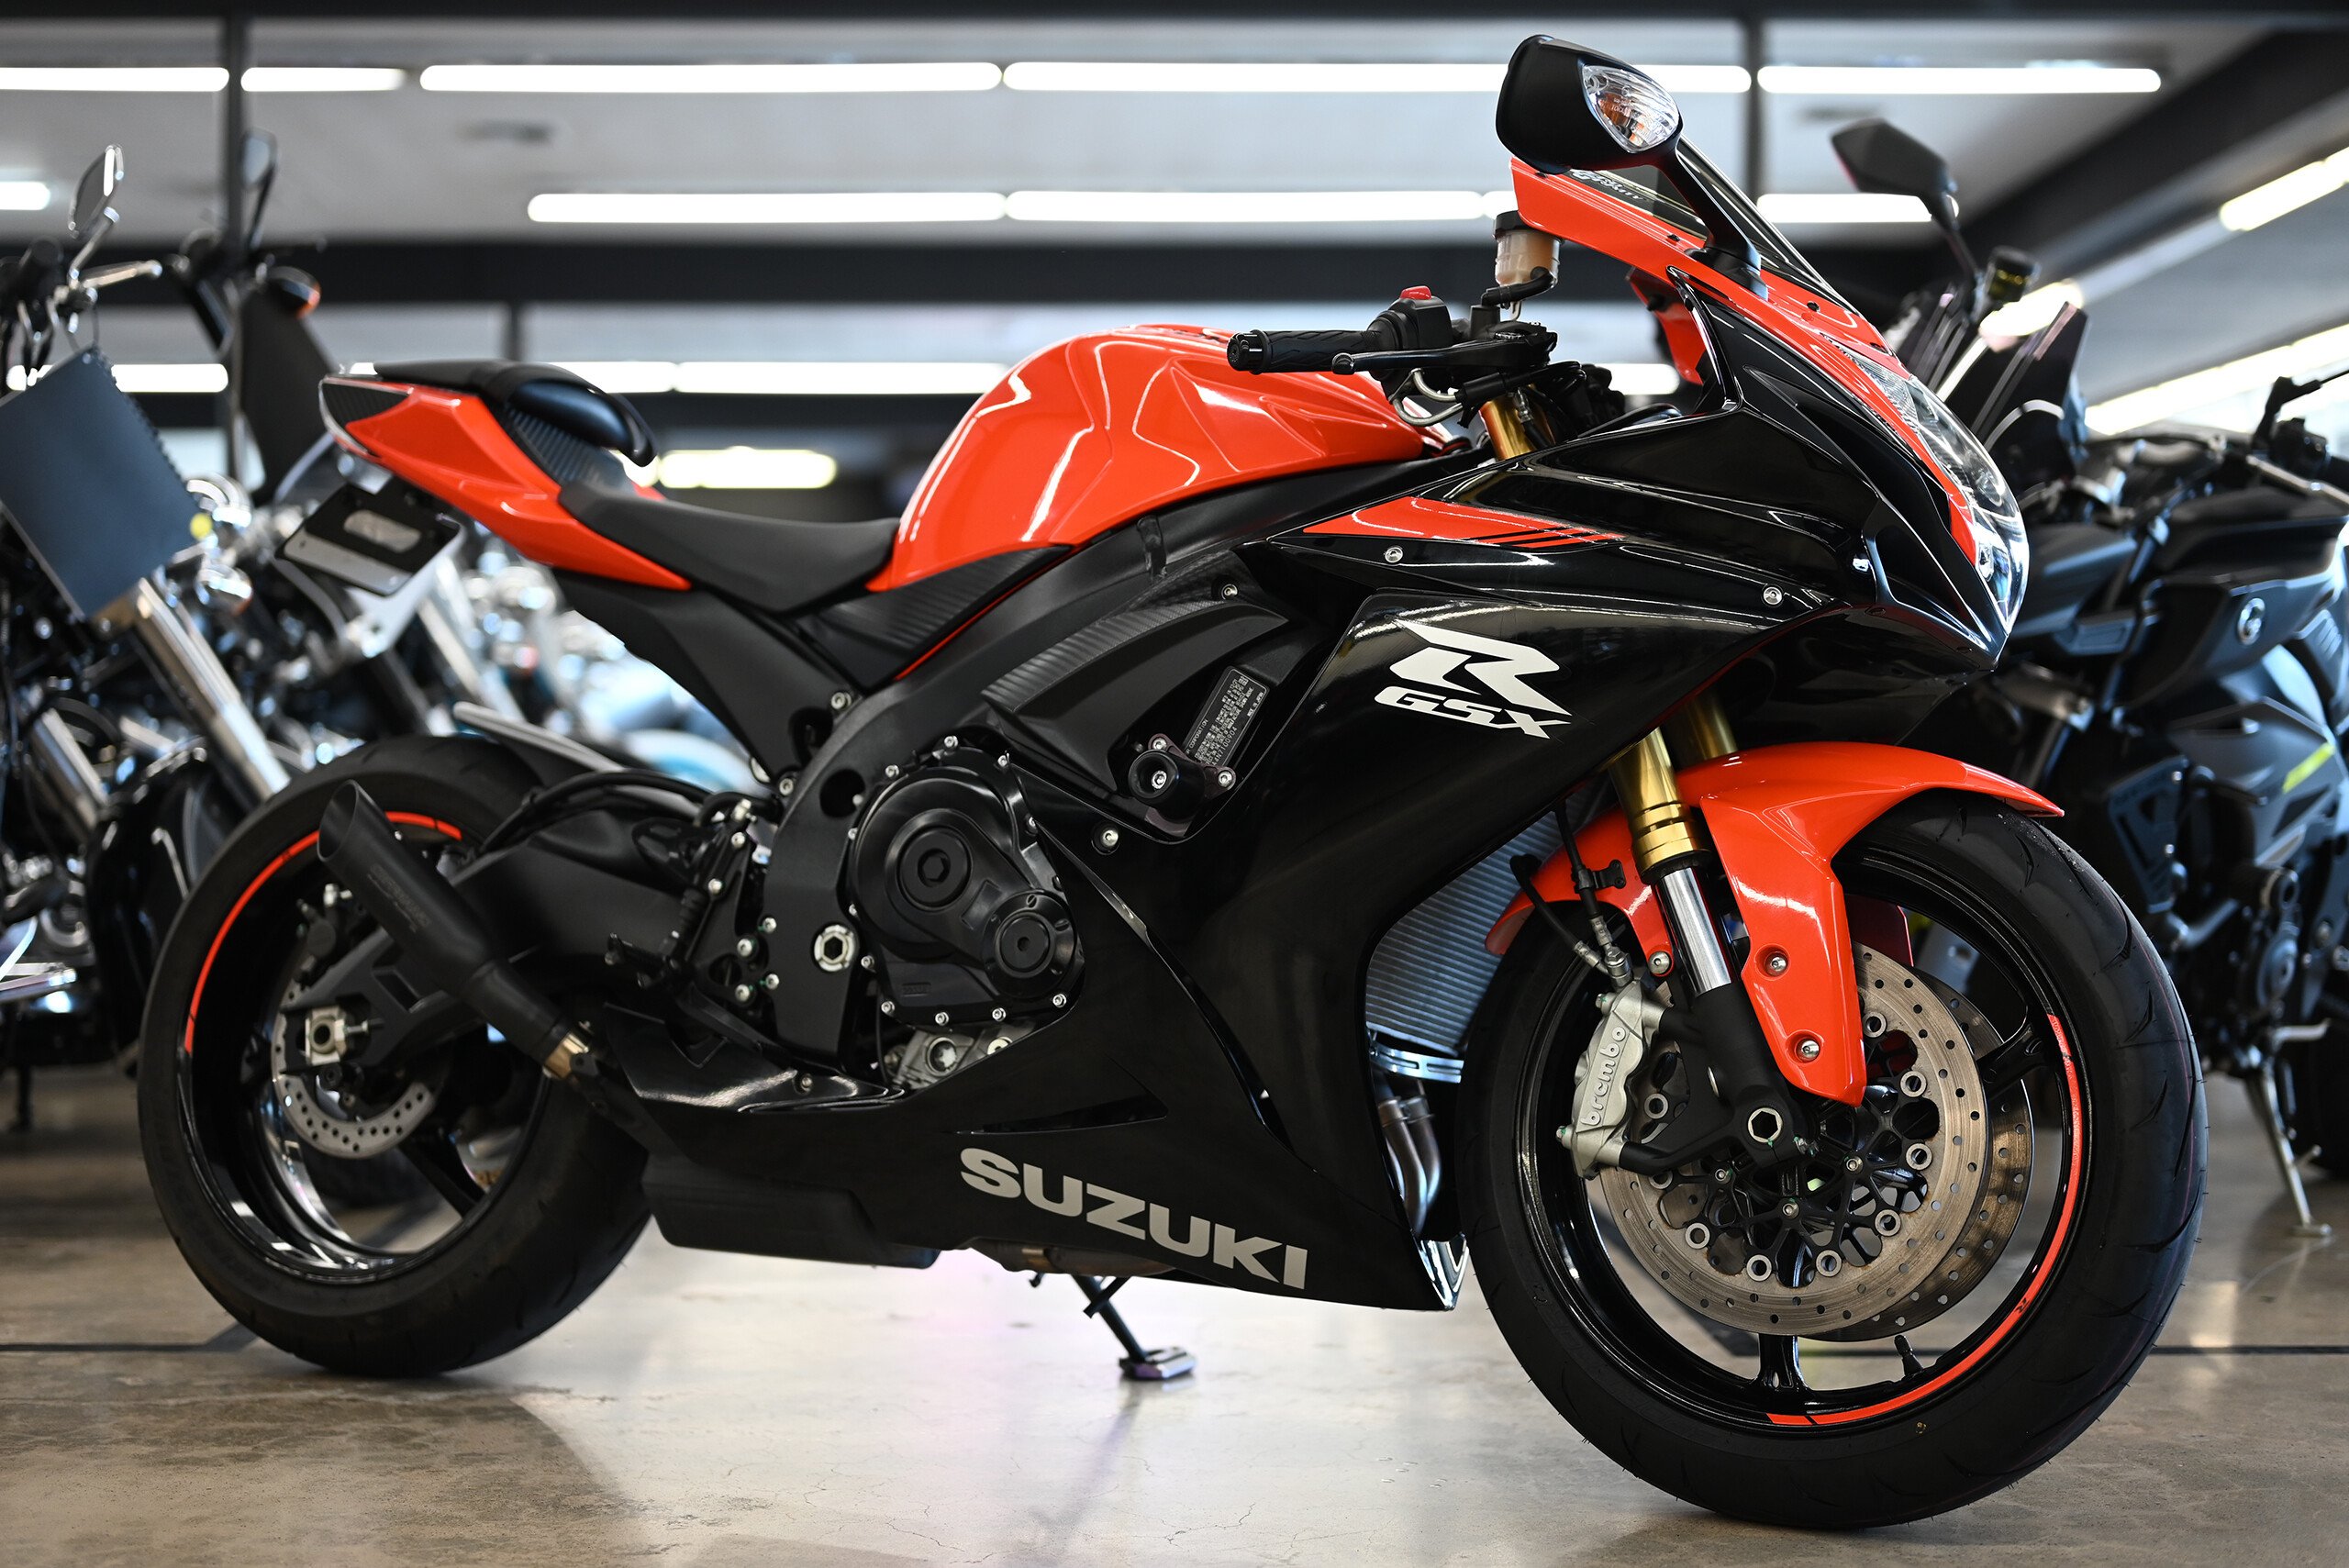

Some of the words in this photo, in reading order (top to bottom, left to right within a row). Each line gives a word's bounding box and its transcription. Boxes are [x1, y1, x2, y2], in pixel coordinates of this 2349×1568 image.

[1189, 718, 1208, 748] CORPORATION
[1374, 685, 1572, 740] GSX
[1580, 1026, 1626, 1126] brembo
[960, 1148, 1308, 1290] SUZUKI
